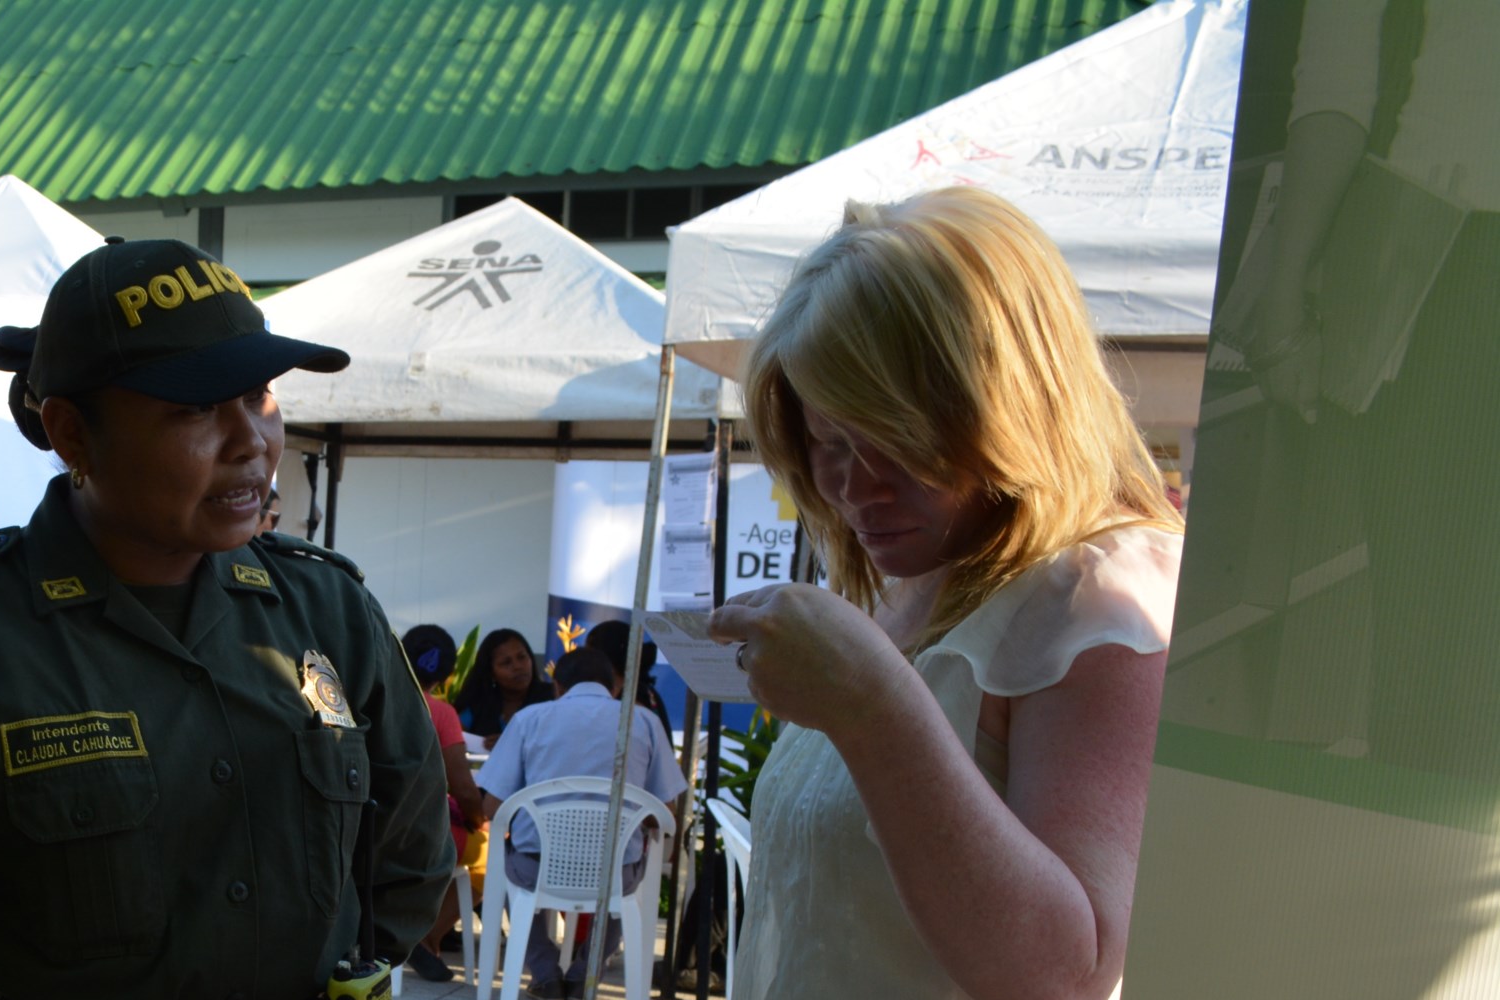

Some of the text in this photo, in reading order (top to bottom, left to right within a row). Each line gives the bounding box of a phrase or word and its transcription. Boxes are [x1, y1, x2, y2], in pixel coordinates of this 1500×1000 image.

[1026, 144, 1227, 170] ANSPE
[417, 253, 543, 270] SENA
[737, 551, 781, 579] DE
[32, 719, 110, 740] Intendente
[16, 736, 134, 765] CLAUDIA CAHUACHE
